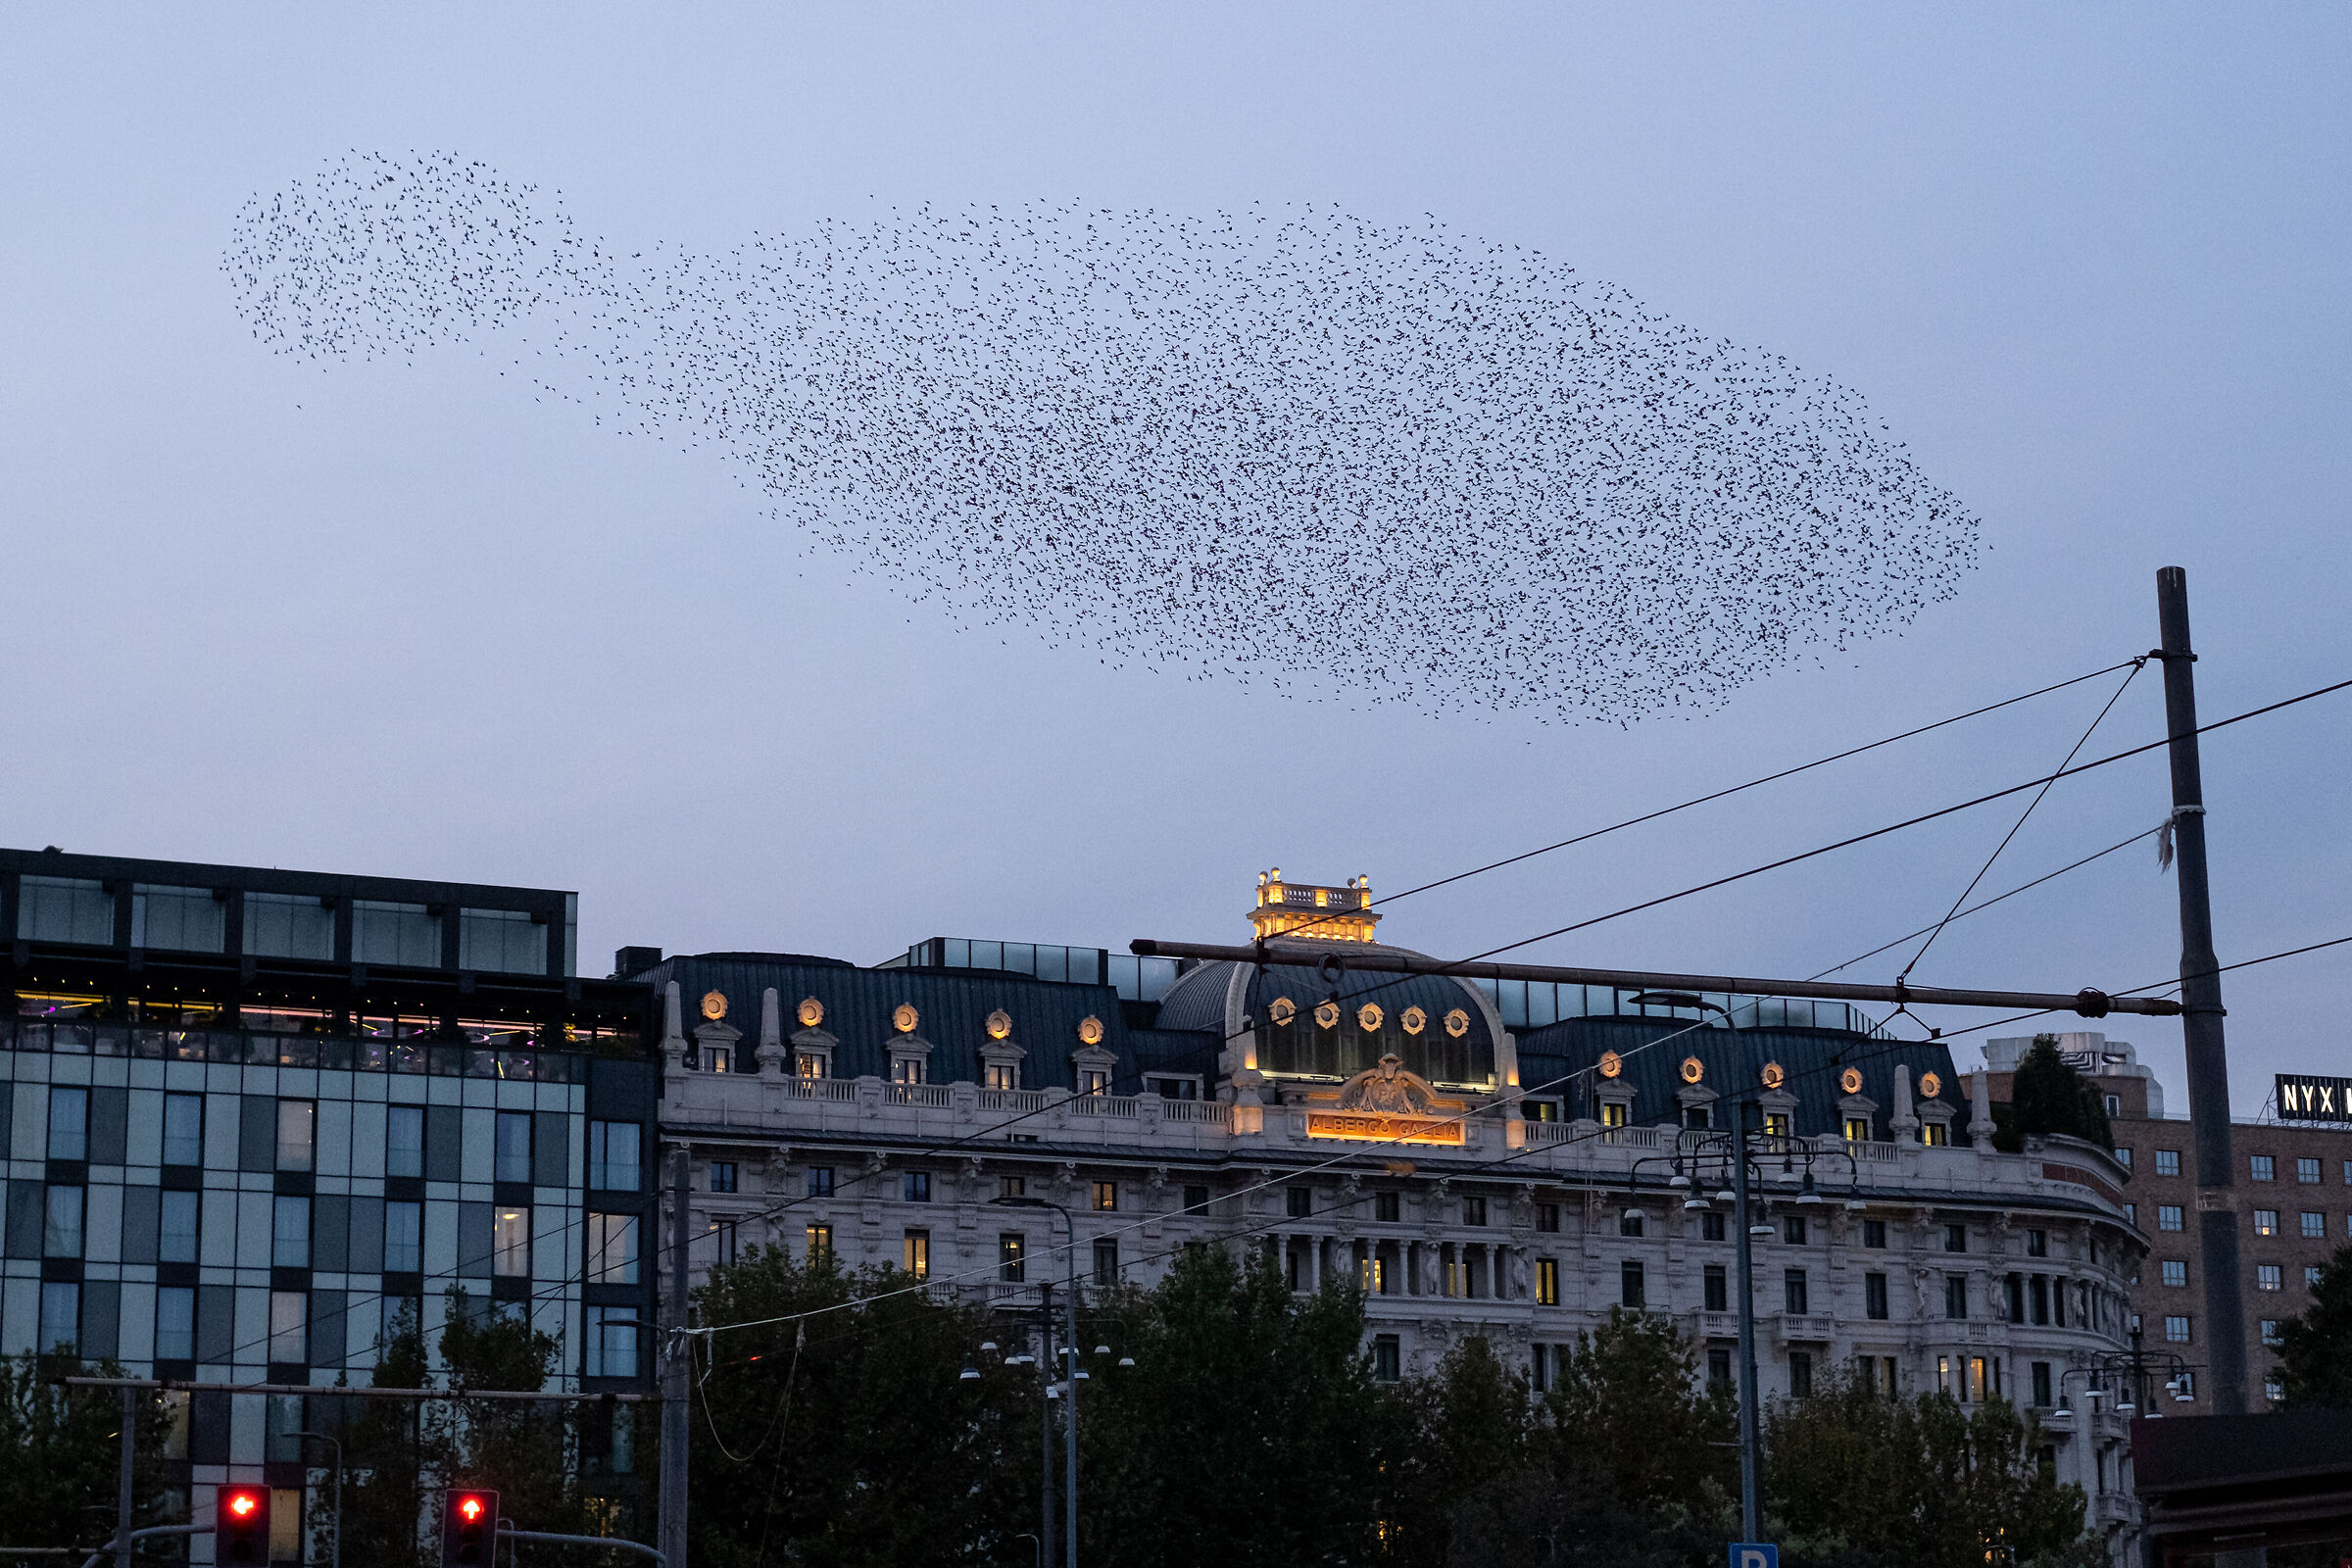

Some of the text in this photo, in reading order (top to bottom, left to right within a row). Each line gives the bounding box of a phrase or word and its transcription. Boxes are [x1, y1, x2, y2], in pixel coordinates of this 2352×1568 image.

[2283, 1084, 2333, 1113] NYX
[1310, 1117, 1459, 1138] ALBERGO GALLIA
